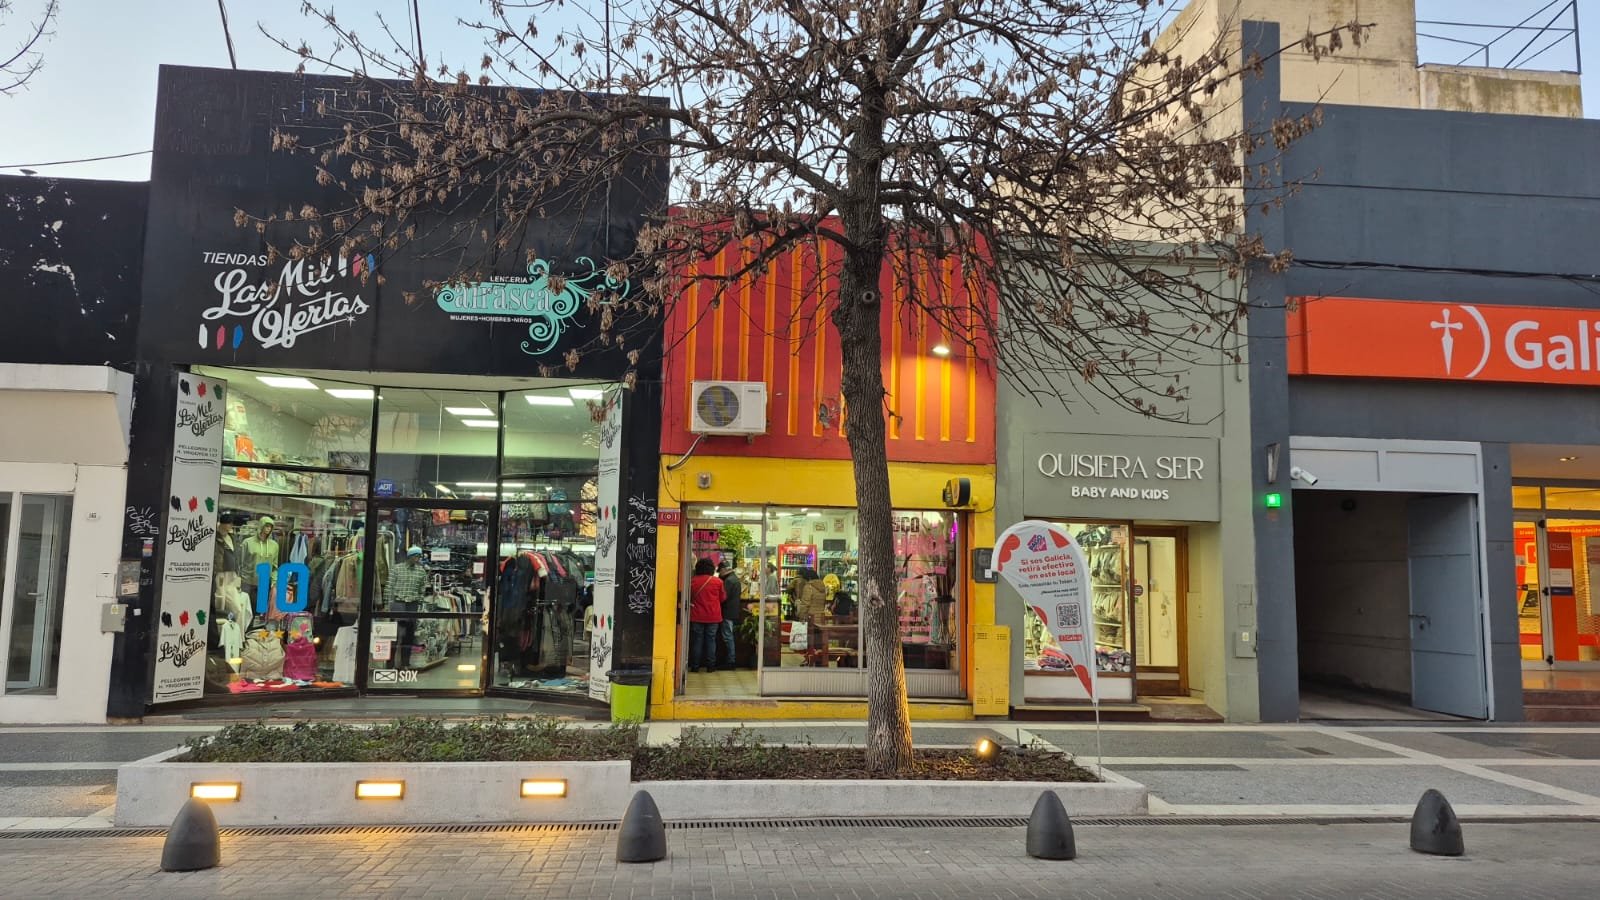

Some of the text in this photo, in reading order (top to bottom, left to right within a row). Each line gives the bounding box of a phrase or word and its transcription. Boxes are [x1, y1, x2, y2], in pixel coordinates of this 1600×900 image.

[203, 252, 268, 267] TIENDAS
[490, 275, 528, 283] LENCERIA
[202, 268, 275, 320] Las
[252, 291, 370, 349] Ofertas
[177, 400, 213, 428] Las Mil
[191, 414, 223, 437] Ofertas
[1038, 453, 1204, 480] QUISIERA SER
[377, 483, 393, 491] ADT
[1071, 486, 1169, 500] BABY AND KIDS
[167, 514, 205, 546] Las Mil
[182, 528, 215, 553] Ofertas
[1042, 561, 1074, 570] efectivo
[1057, 568, 1076, 577] local
[256, 562, 310, 613] 10
[158, 628, 195, 662] Las Mil
[173, 640, 206, 668] Ofertas
[399, 670, 418, 682] SOX
